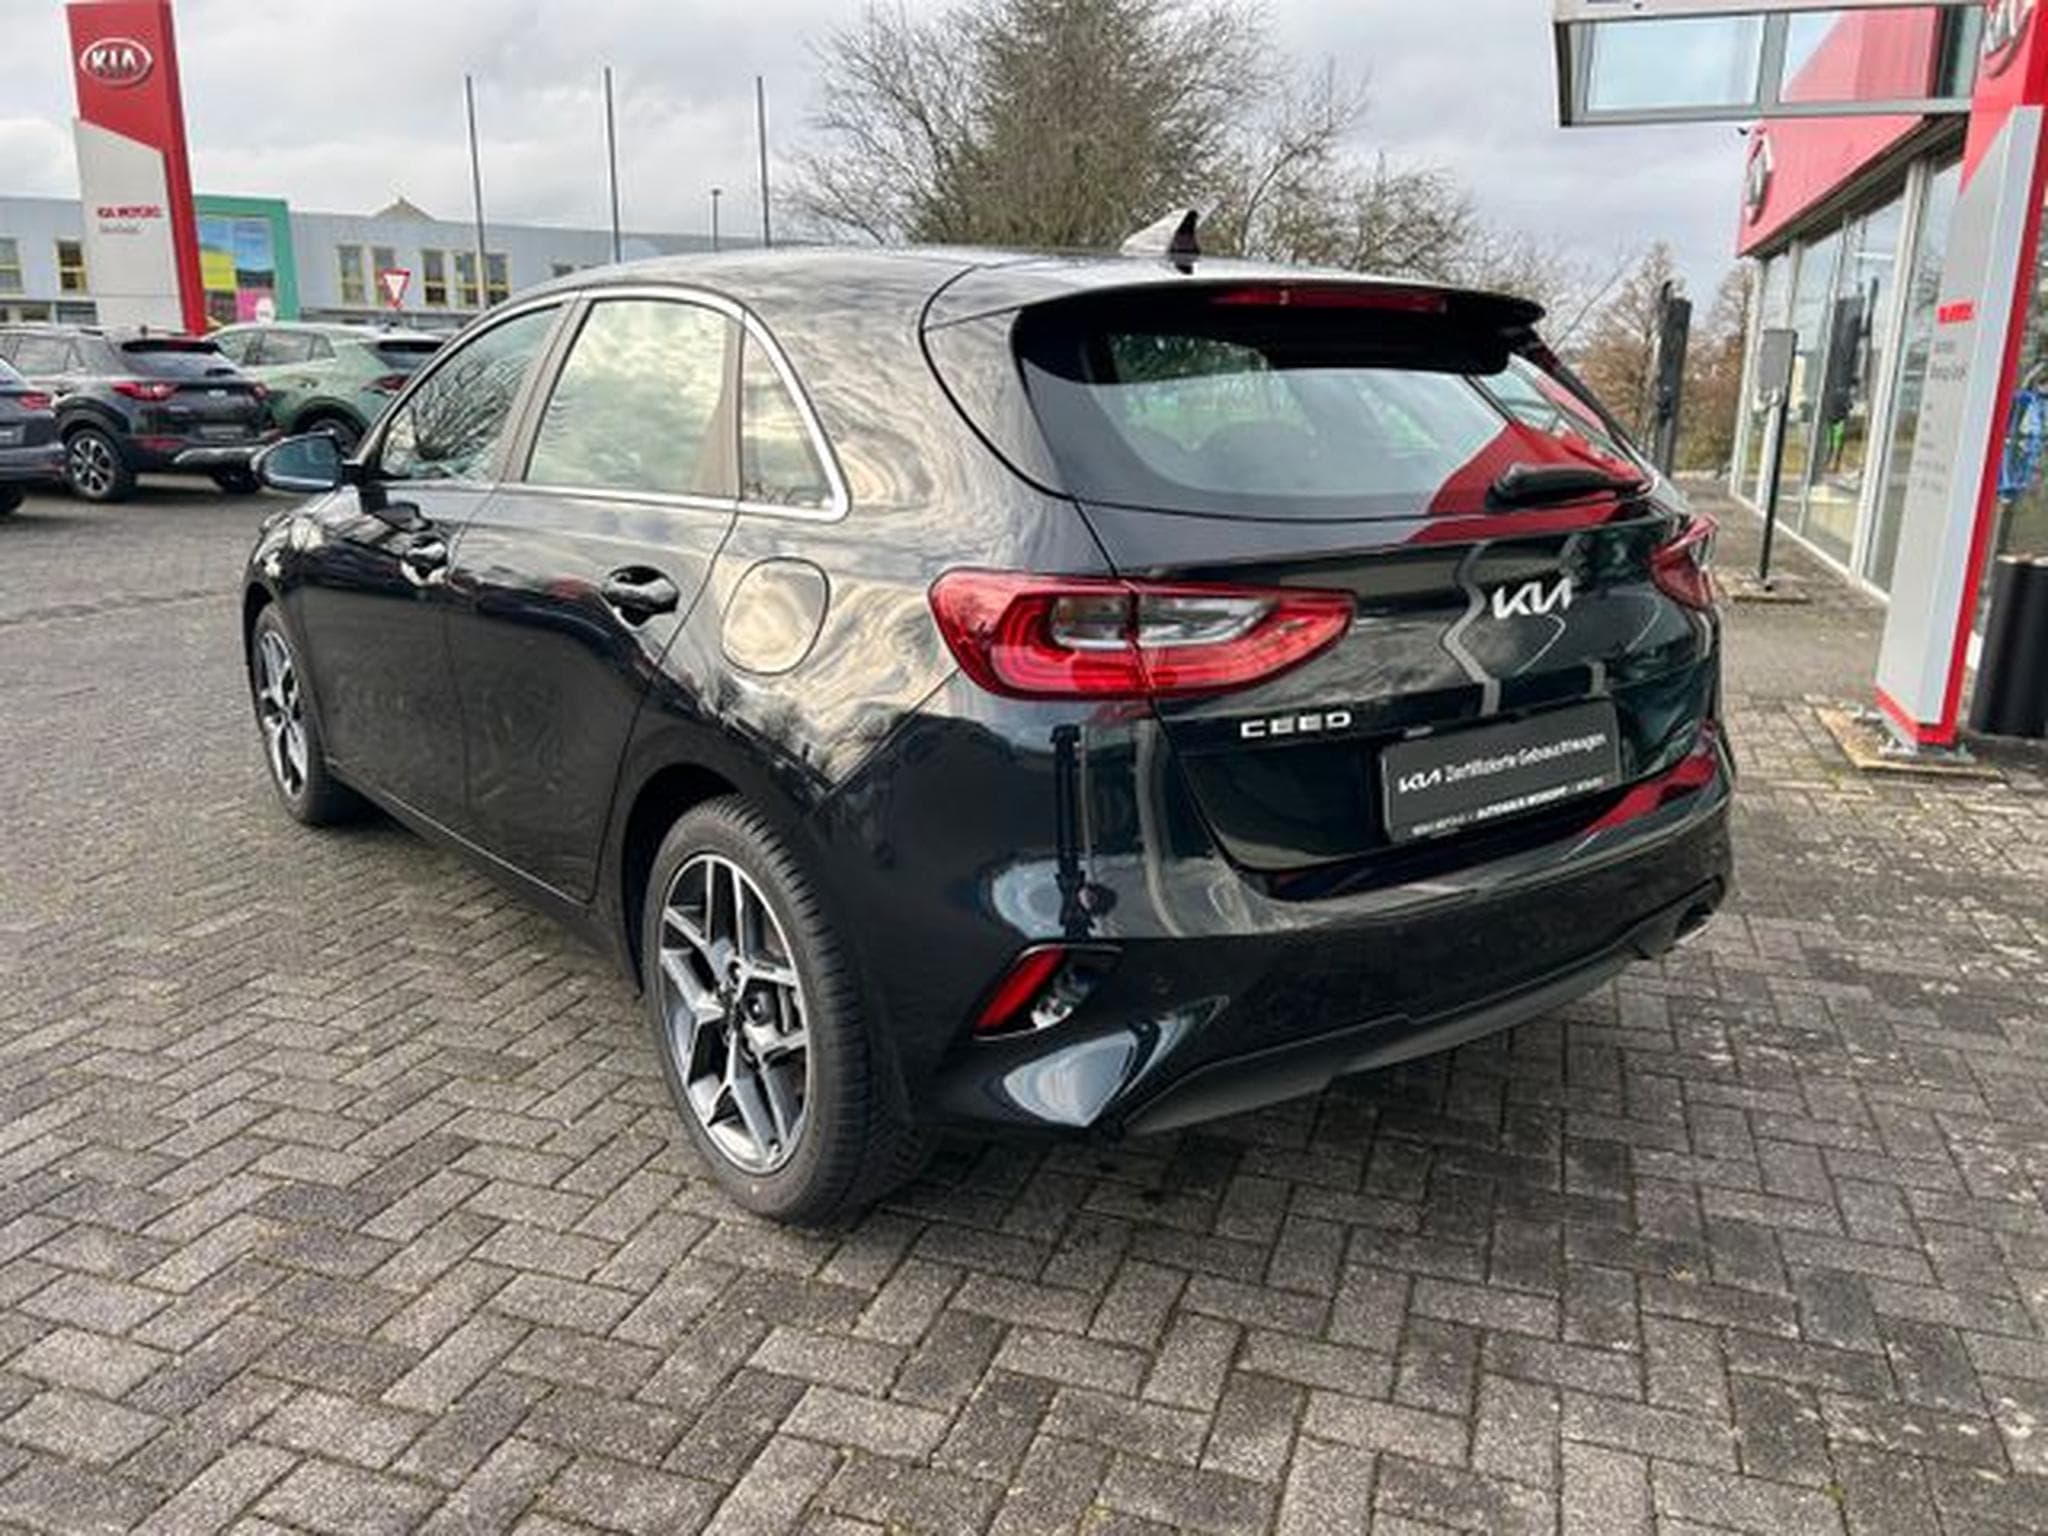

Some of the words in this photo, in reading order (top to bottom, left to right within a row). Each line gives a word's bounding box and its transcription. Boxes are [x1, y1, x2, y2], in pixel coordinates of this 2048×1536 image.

[91, 49, 138, 71] KIA
[1492, 577, 1572, 619] KIA
[1241, 711, 1352, 739] CEED
